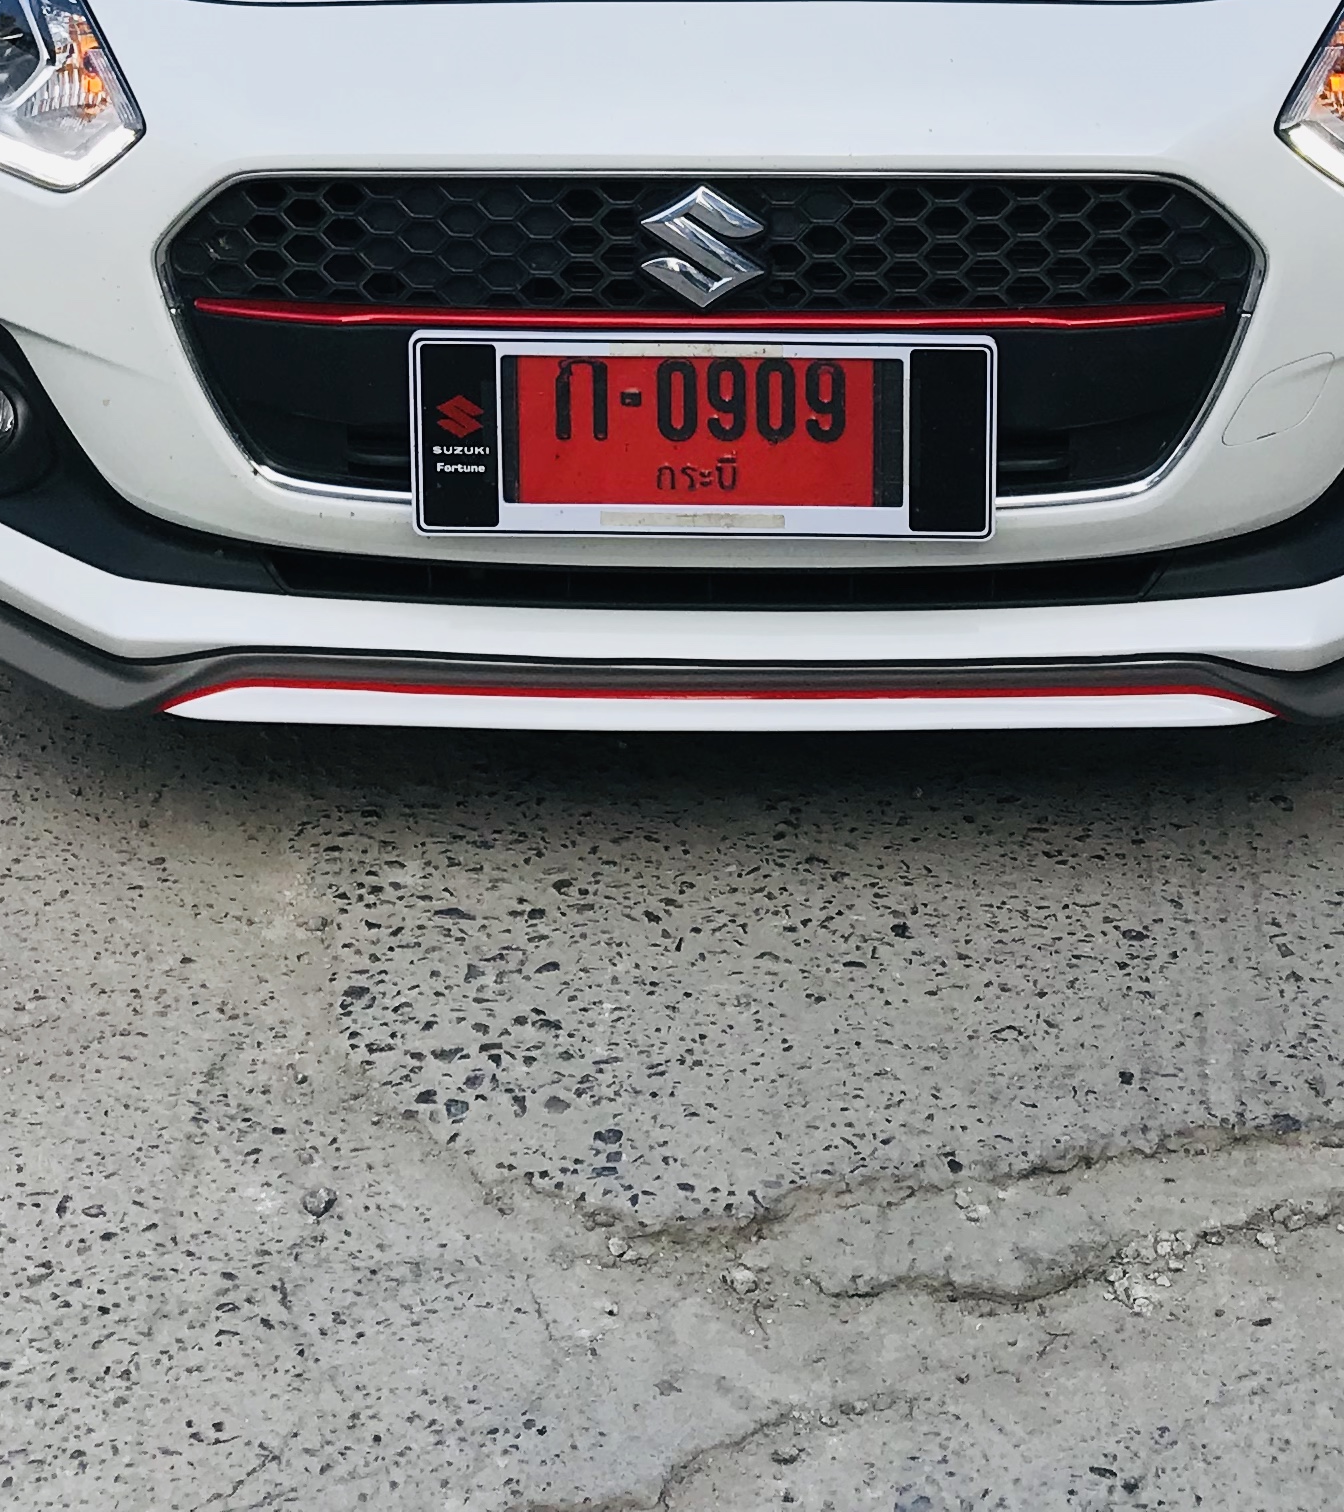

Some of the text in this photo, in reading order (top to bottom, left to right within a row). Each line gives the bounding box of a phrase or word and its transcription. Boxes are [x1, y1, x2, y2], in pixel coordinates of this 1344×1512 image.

[555, 358, 846, 444] ก-0909
[432, 445, 490, 455] SUZUKI
[436, 462, 486, 473] Fortune
